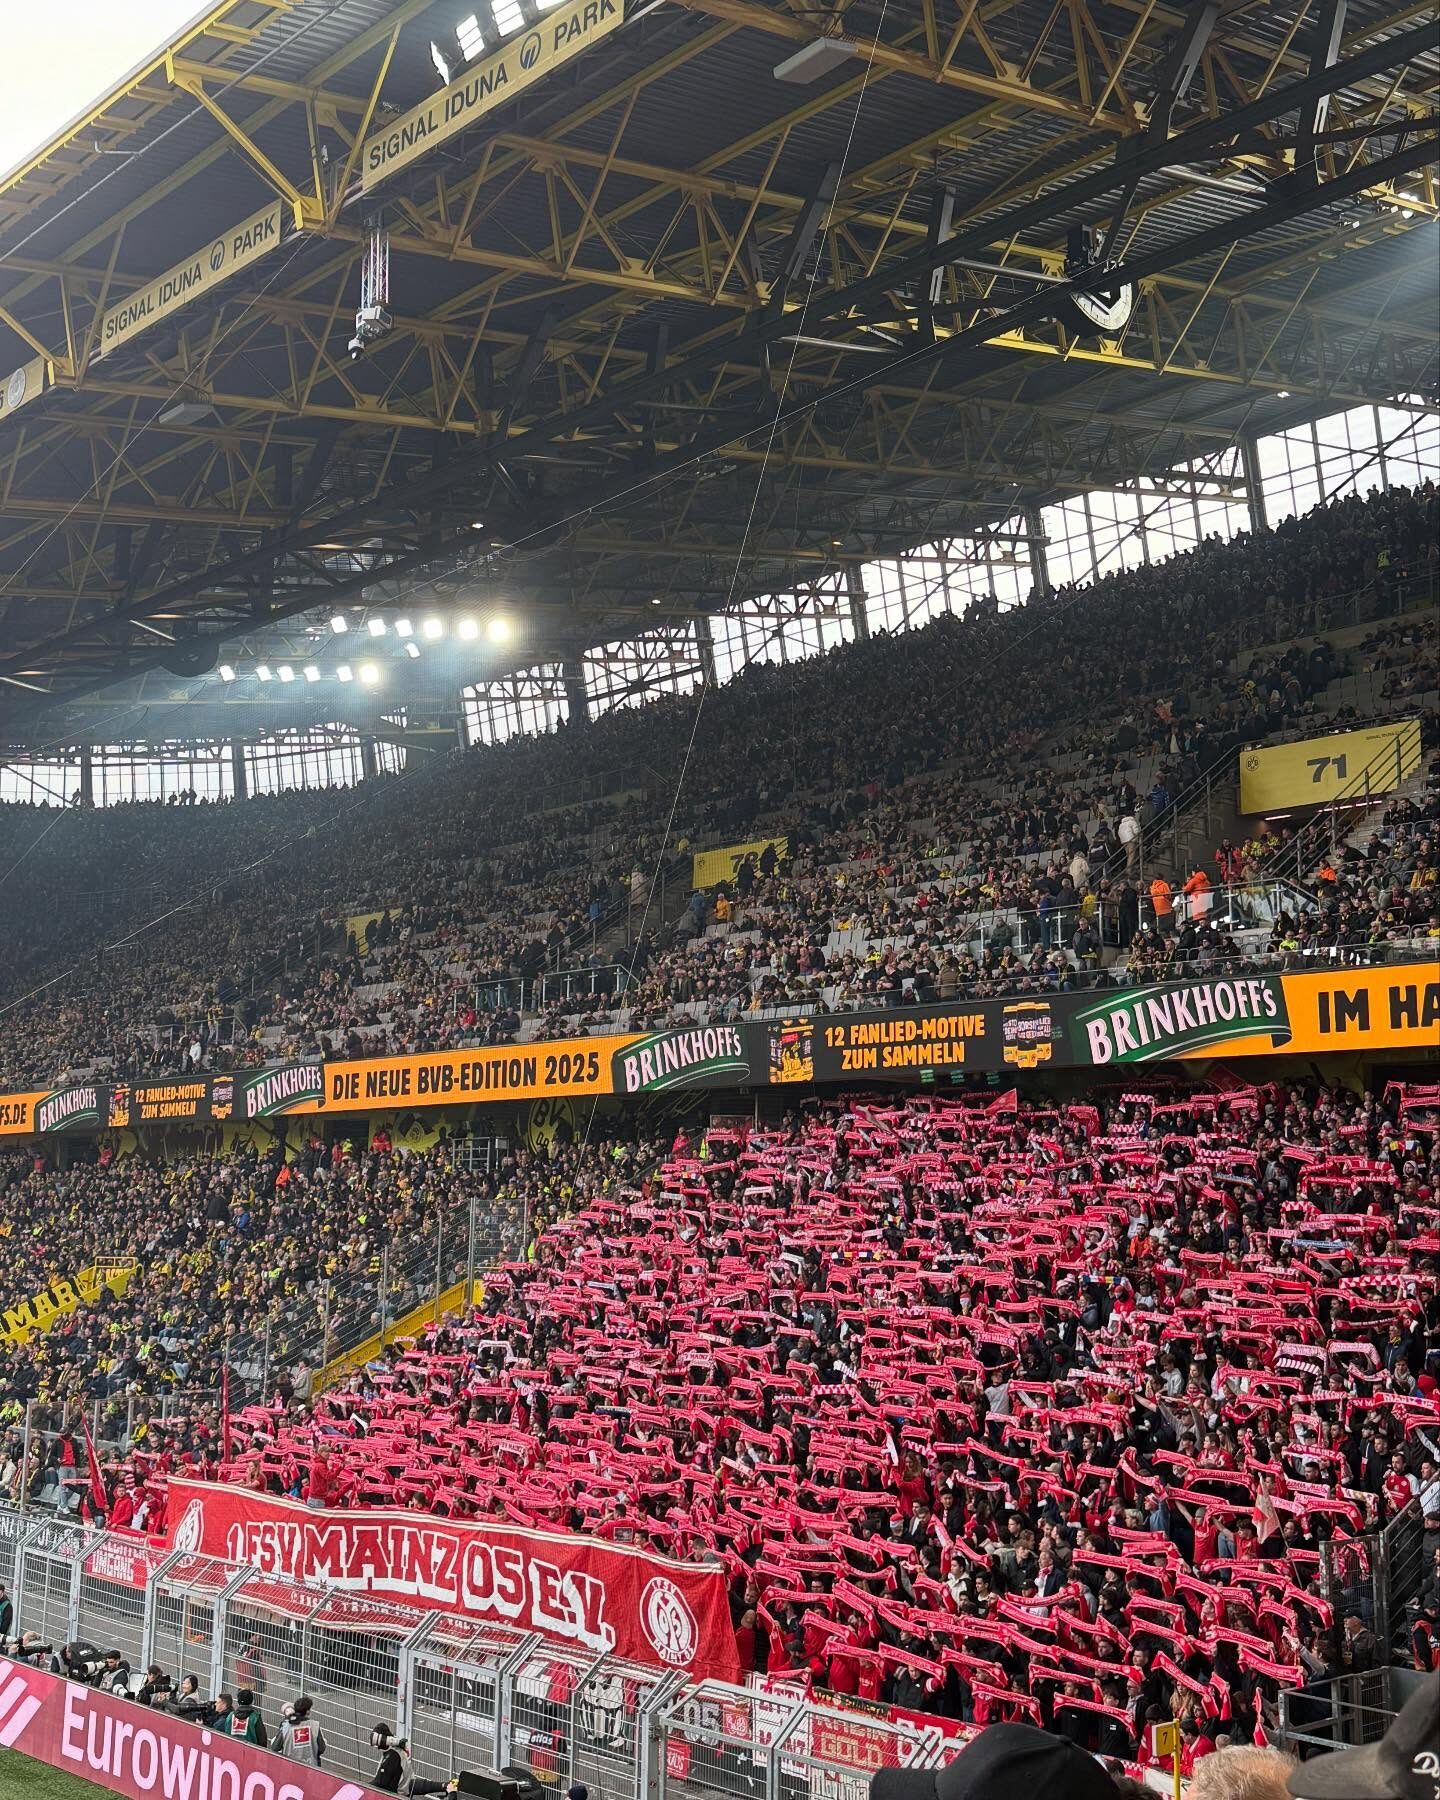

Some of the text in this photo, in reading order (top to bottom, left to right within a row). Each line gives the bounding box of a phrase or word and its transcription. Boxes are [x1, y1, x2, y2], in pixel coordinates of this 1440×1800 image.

[369, 0, 616, 170] SIGNAL IDUNA PARK
[106, 213, 275, 339] SIGNAL IDUNA PARK
[1306, 753, 1347, 783] 71
[1318, 988, 1370, 1033] IM
[824, 1026, 845, 1047] 12
[850, 1014, 985, 1046] FANLIED-MOTIVE
[841, 1041, 965, 1070] ZUM SAMMELN
[135, 1089, 145, 1104] 12
[146, 1083, 206, 1102] FANLIED-MOTIVE
[333, 1052, 599, 1100] DIE NEUE BVB-EDITION 2025
[141, 1100, 197, 1119] ZUM SAMMELN
[302, 1523, 461, 1604] MAINZ
[463, 1540, 526, 1618] 05
[62, 1682, 305, 1800] Eurowin
[1162, 1731, 1168, 1745] 7
